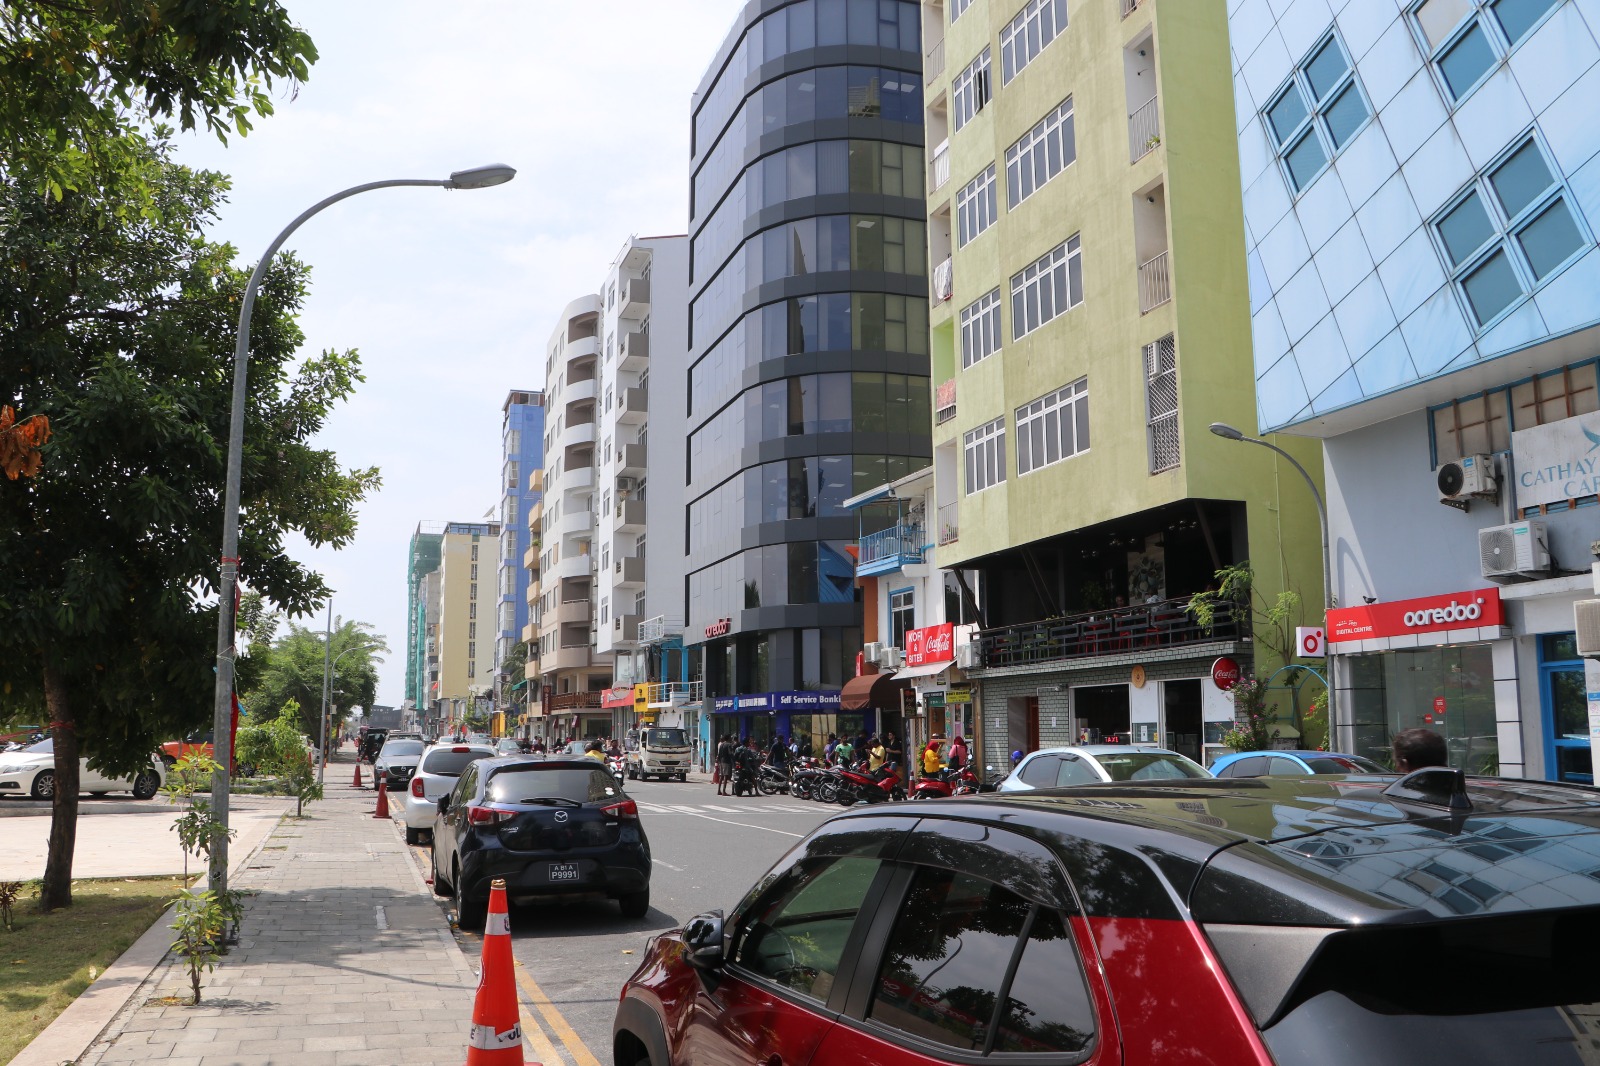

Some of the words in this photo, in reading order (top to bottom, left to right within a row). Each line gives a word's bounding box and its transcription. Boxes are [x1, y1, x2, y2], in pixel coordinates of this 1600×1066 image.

[1521, 457, 1597, 488] CATHAY
[1404, 598, 1484, 627] ooredoo
[1354, 626, 1372, 634] CENTRE
[908, 631, 923, 642] KOFI
[909, 653, 922, 663] BITES
[780, 695, 792, 704] Self
[793, 695, 817, 704] Service
[552, 871, 577, 879] P9991
